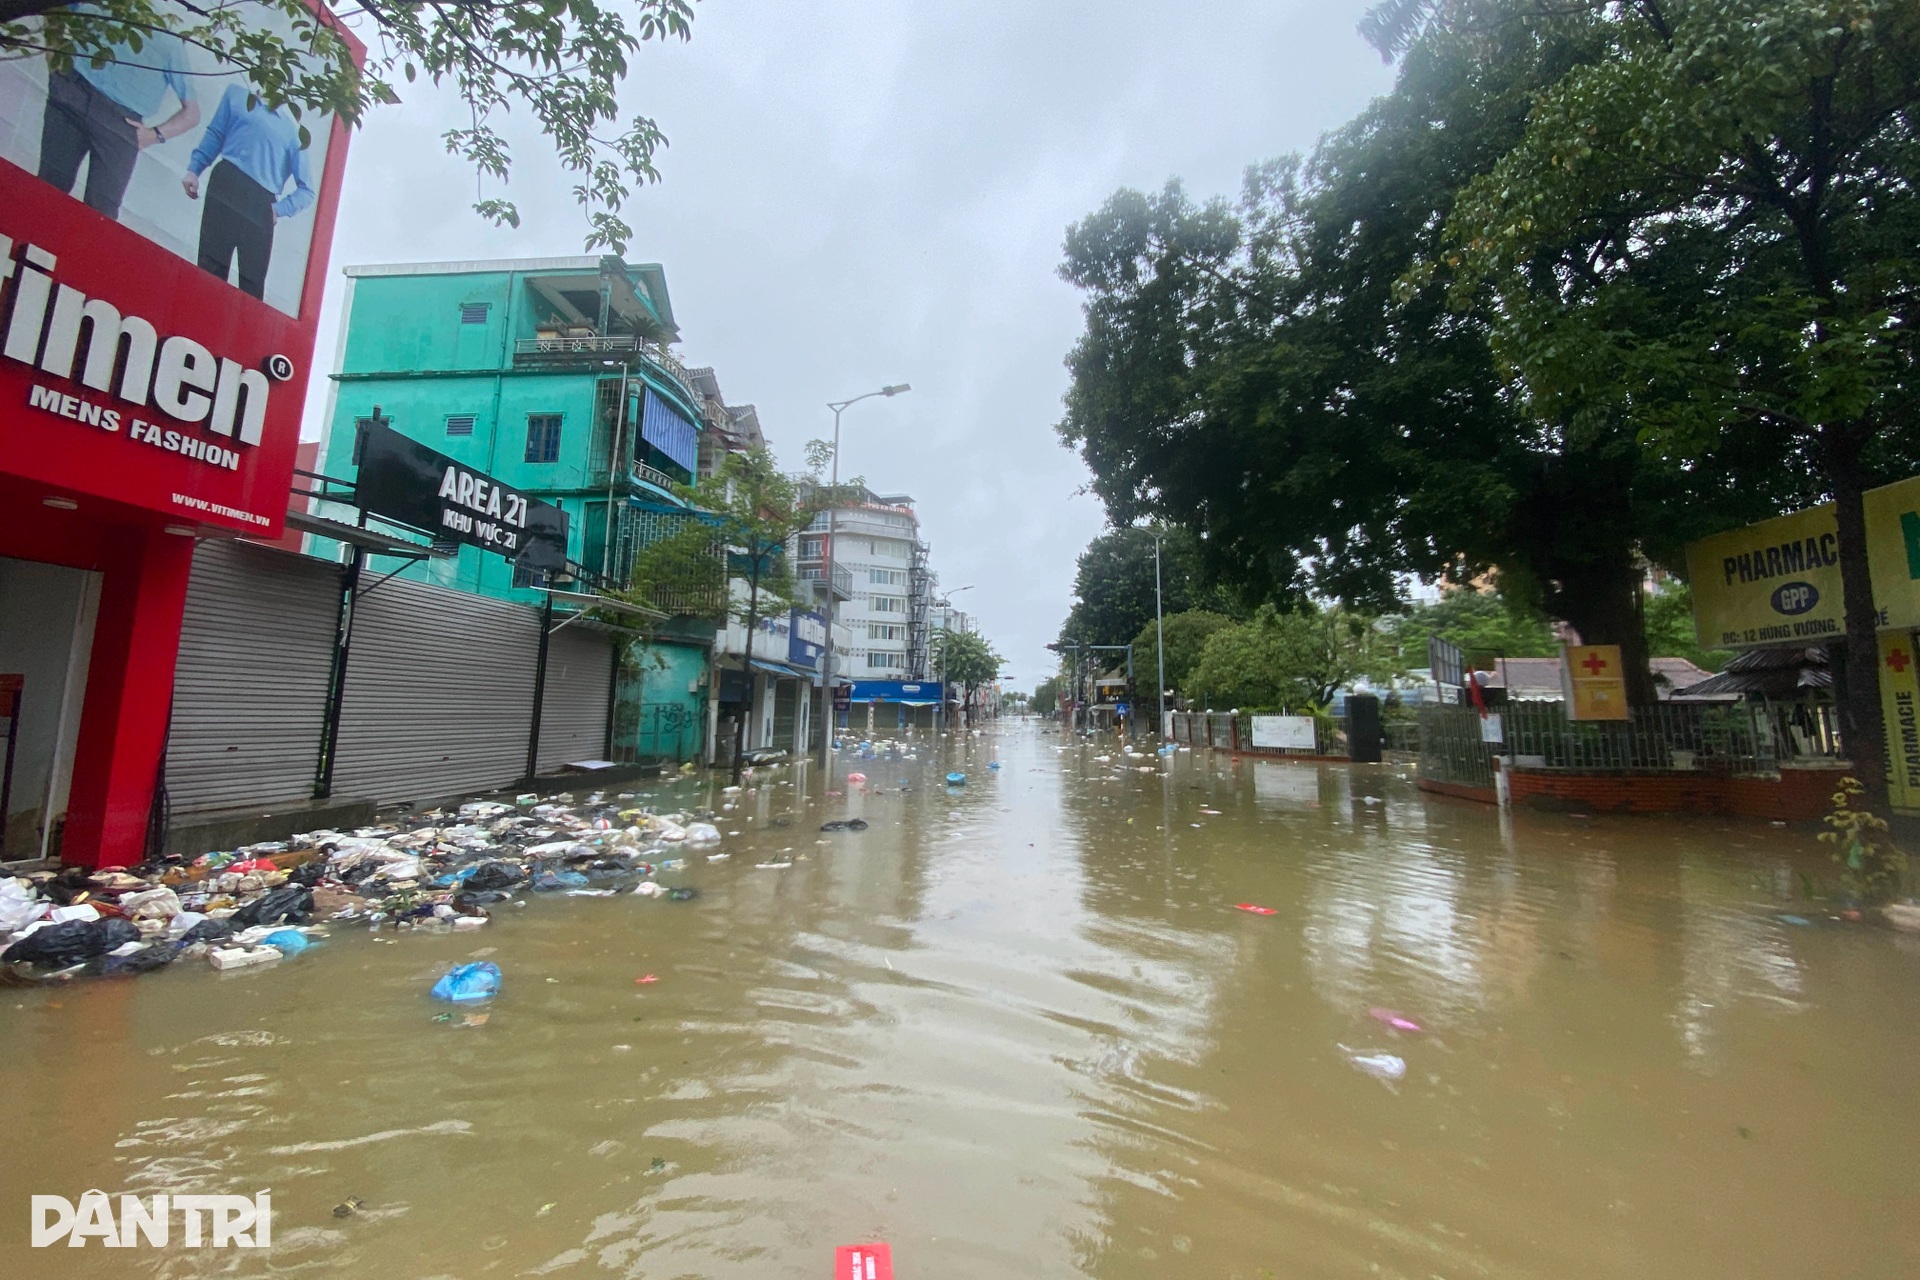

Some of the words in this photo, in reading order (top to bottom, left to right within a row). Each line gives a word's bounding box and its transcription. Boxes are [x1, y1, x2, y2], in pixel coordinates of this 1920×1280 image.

[29, 384, 121, 432] MENS
[130, 418, 240, 470] FASHION
[172, 492, 270, 527] WWW.VITIMEN.VN
[438, 466, 501, 519] AREA
[503, 494, 527, 528] 21
[442, 508, 472, 534] KHU
[475, 520, 502, 546] VỰC
[503, 531, 517, 549] 21
[1722, 531, 1840, 586] PHARMAC
[1780, 586, 1809, 611] GPP
[1743, 628, 1757, 642] 12
[1759, 623, 1791, 641] HÙNG
[1896, 691, 1920, 787] PHARMACIE
